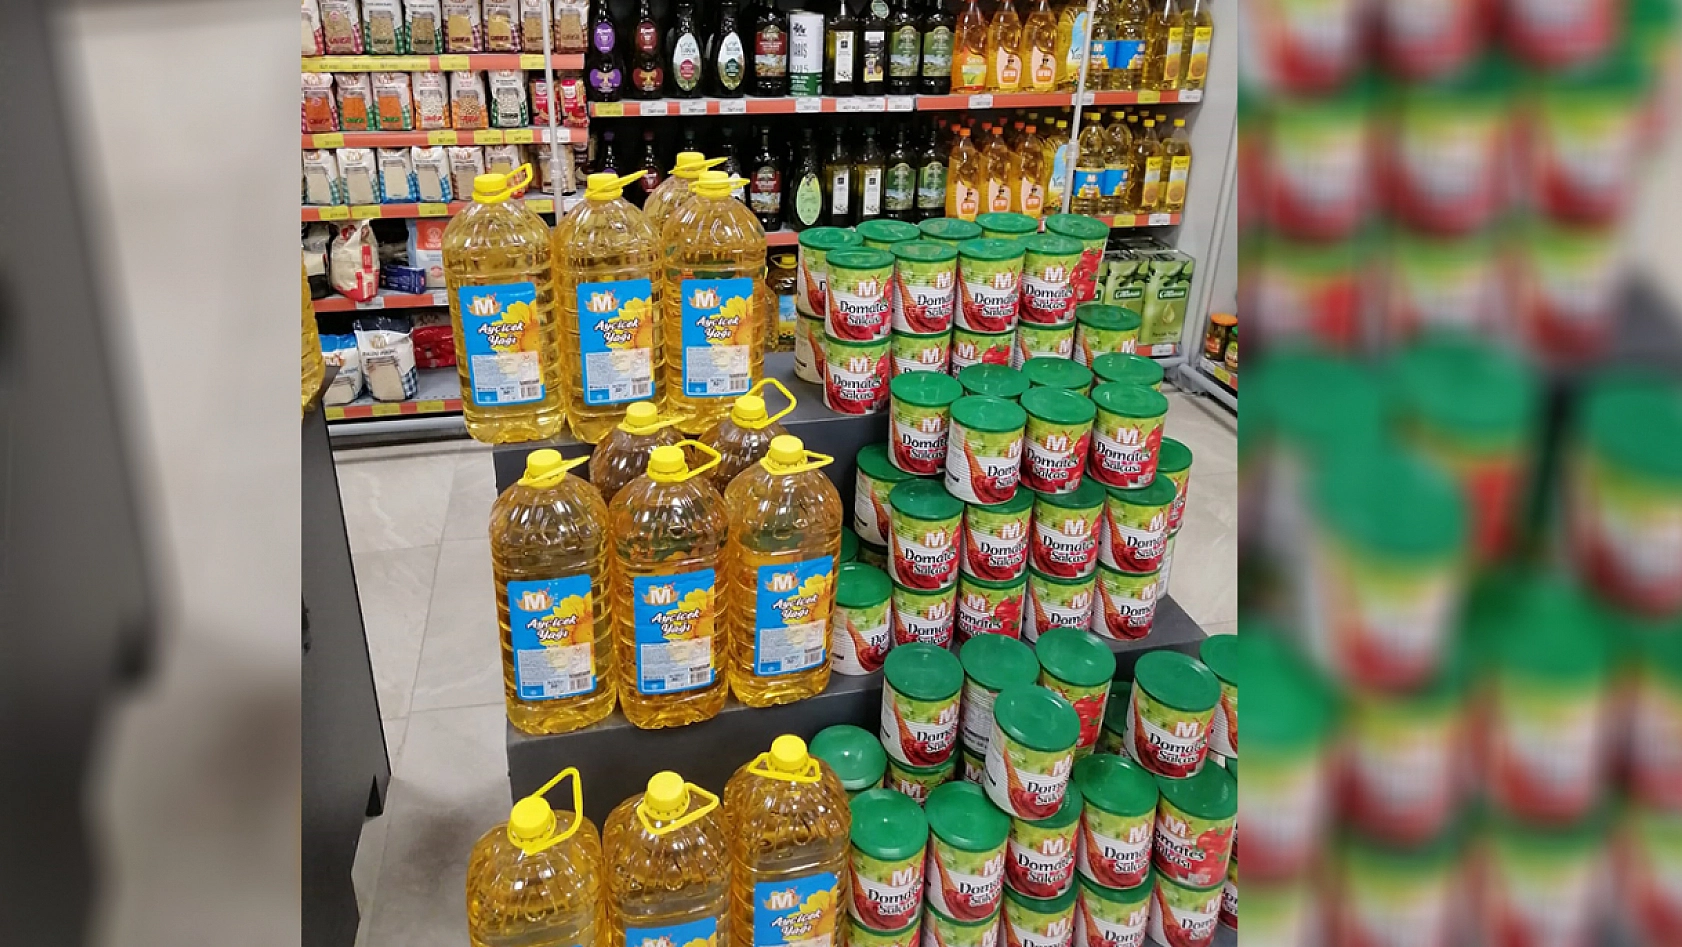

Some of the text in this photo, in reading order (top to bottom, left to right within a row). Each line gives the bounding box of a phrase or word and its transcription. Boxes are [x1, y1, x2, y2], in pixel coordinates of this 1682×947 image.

[995, 272, 1012, 289] M
[1045, 267, 1064, 281] M
[858, 281, 877, 296] M
[1026, 283, 1073, 298] Domates
[474, 297, 494, 314] M
[593, 295, 612, 312] M
[695, 293, 714, 308] M
[840, 299, 889, 315] Domates
[922, 348, 939, 363] M
[957, 342, 975, 359] M
[849, 357, 868, 372] M
[833, 373, 881, 389] Domates
[921, 417, 941, 432] M
[1046, 435, 1067, 451] M
[1116, 427, 1139, 444] M
[1027, 449, 1078, 468] Domates
[1097, 441, 1151, 462] Domates
[1002, 523, 1020, 539] M
[1064, 519, 1085, 535] M
[925, 532, 946, 547] M
[1043, 535, 1095, 551] Domates
[905, 547, 956, 563] Domates
[773, 574, 793, 591] M
[524, 594, 546, 610] M
[649, 588, 671, 604] M
[967, 595, 986, 612] M
[1072, 593, 1089, 609] M
[928, 602, 946, 620] M
[960, 610, 1003, 630] omates
[938, 704, 957, 724] M
[1176, 721, 1200, 738] M
[966, 763, 983, 783] M
[1053, 755, 1073, 777] M
[901, 780, 921, 797] M
[1129, 824, 1148, 843] M
[1166, 814, 1187, 838] M
[1042, 837, 1064, 854] M
[984, 855, 1004, 876] M
[892, 866, 914, 887] M
[772, 892, 793, 909] M
[1129, 906, 1147, 928] M
[1047, 918, 1067, 937] M
